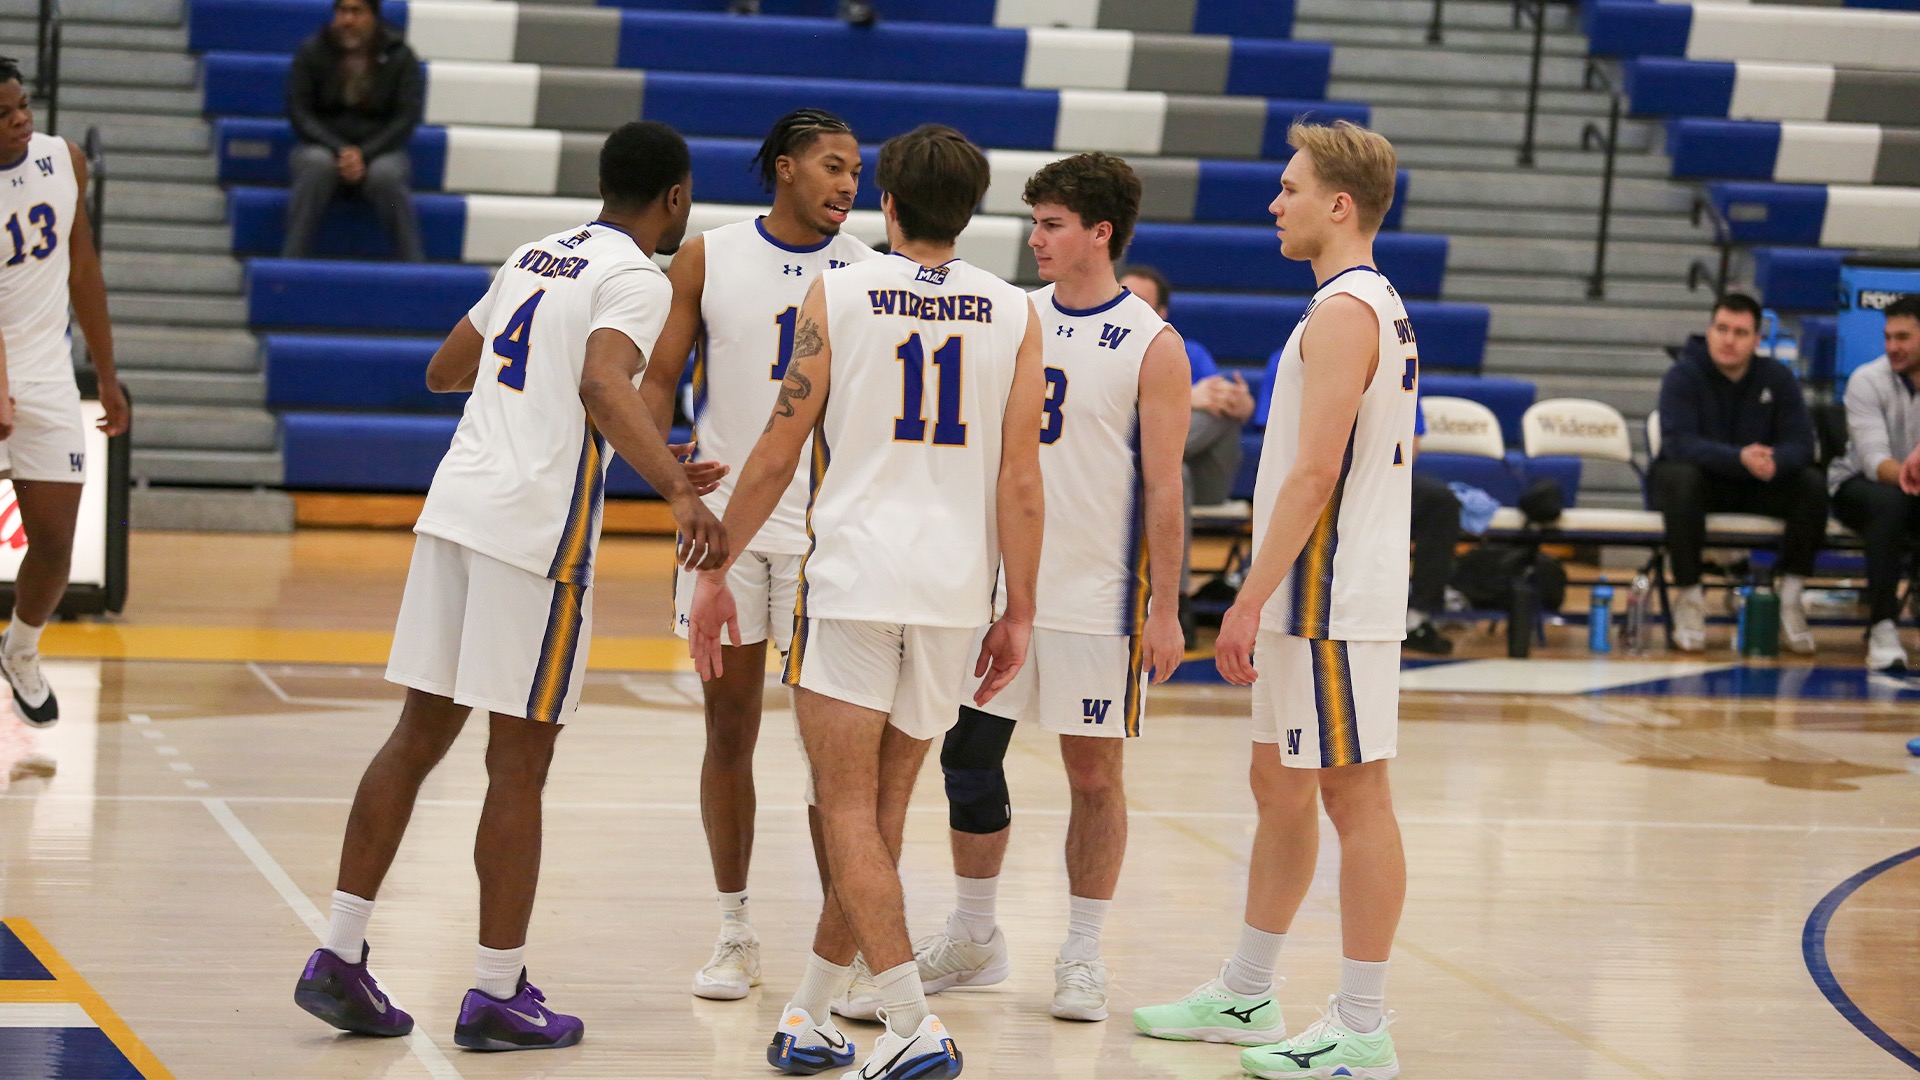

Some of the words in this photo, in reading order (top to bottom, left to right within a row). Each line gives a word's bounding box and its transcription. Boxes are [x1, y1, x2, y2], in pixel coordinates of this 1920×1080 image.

[35, 156, 54, 176] W
[5, 202, 58, 267] 13
[514, 248, 589, 280] WDENER
[917, 270, 945, 284] MAC
[867, 288, 993, 324] WIDENER
[492, 285, 547, 394] 4
[1098, 322, 1131, 350] W
[892, 329, 969, 448] 11
[1427, 412, 1489, 435] idener
[1082, 698, 1112, 725] W
